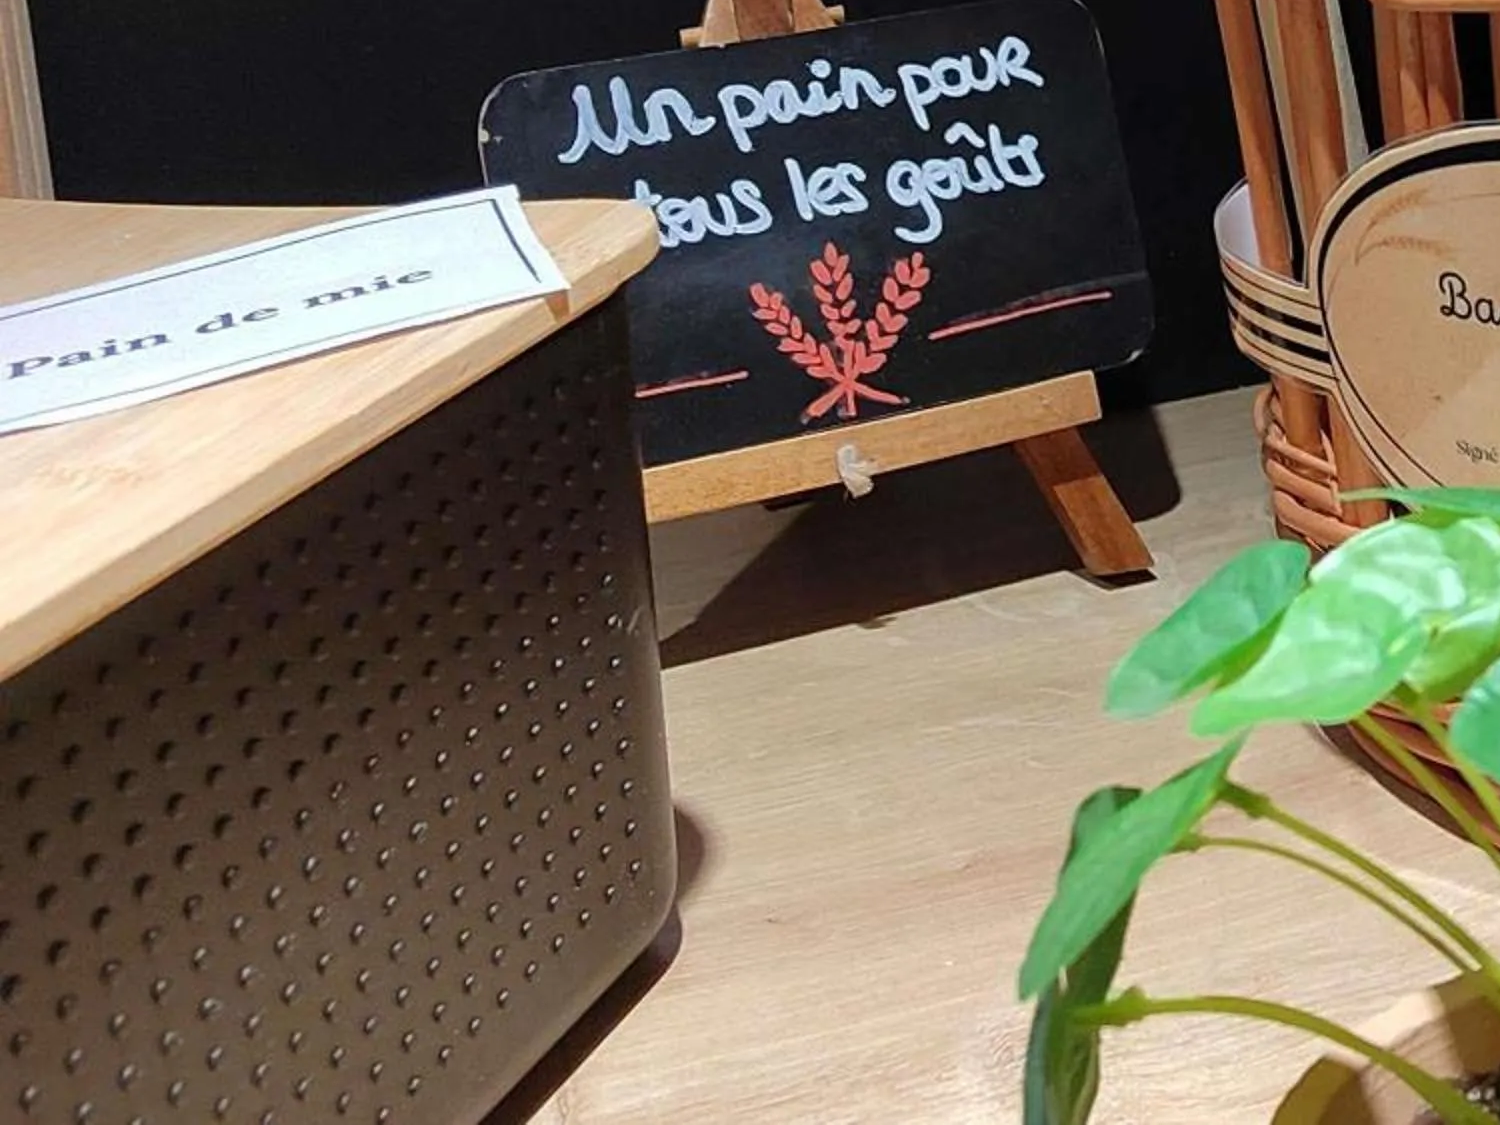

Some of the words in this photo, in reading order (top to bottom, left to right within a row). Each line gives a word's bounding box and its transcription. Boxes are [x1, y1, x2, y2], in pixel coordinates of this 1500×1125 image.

[717, 58, 896, 153] pain
[785, 157, 869, 222] les
[8, 331, 172, 379] Pain
[194, 306, 281, 334] de
[302, 269, 433, 309] mie
